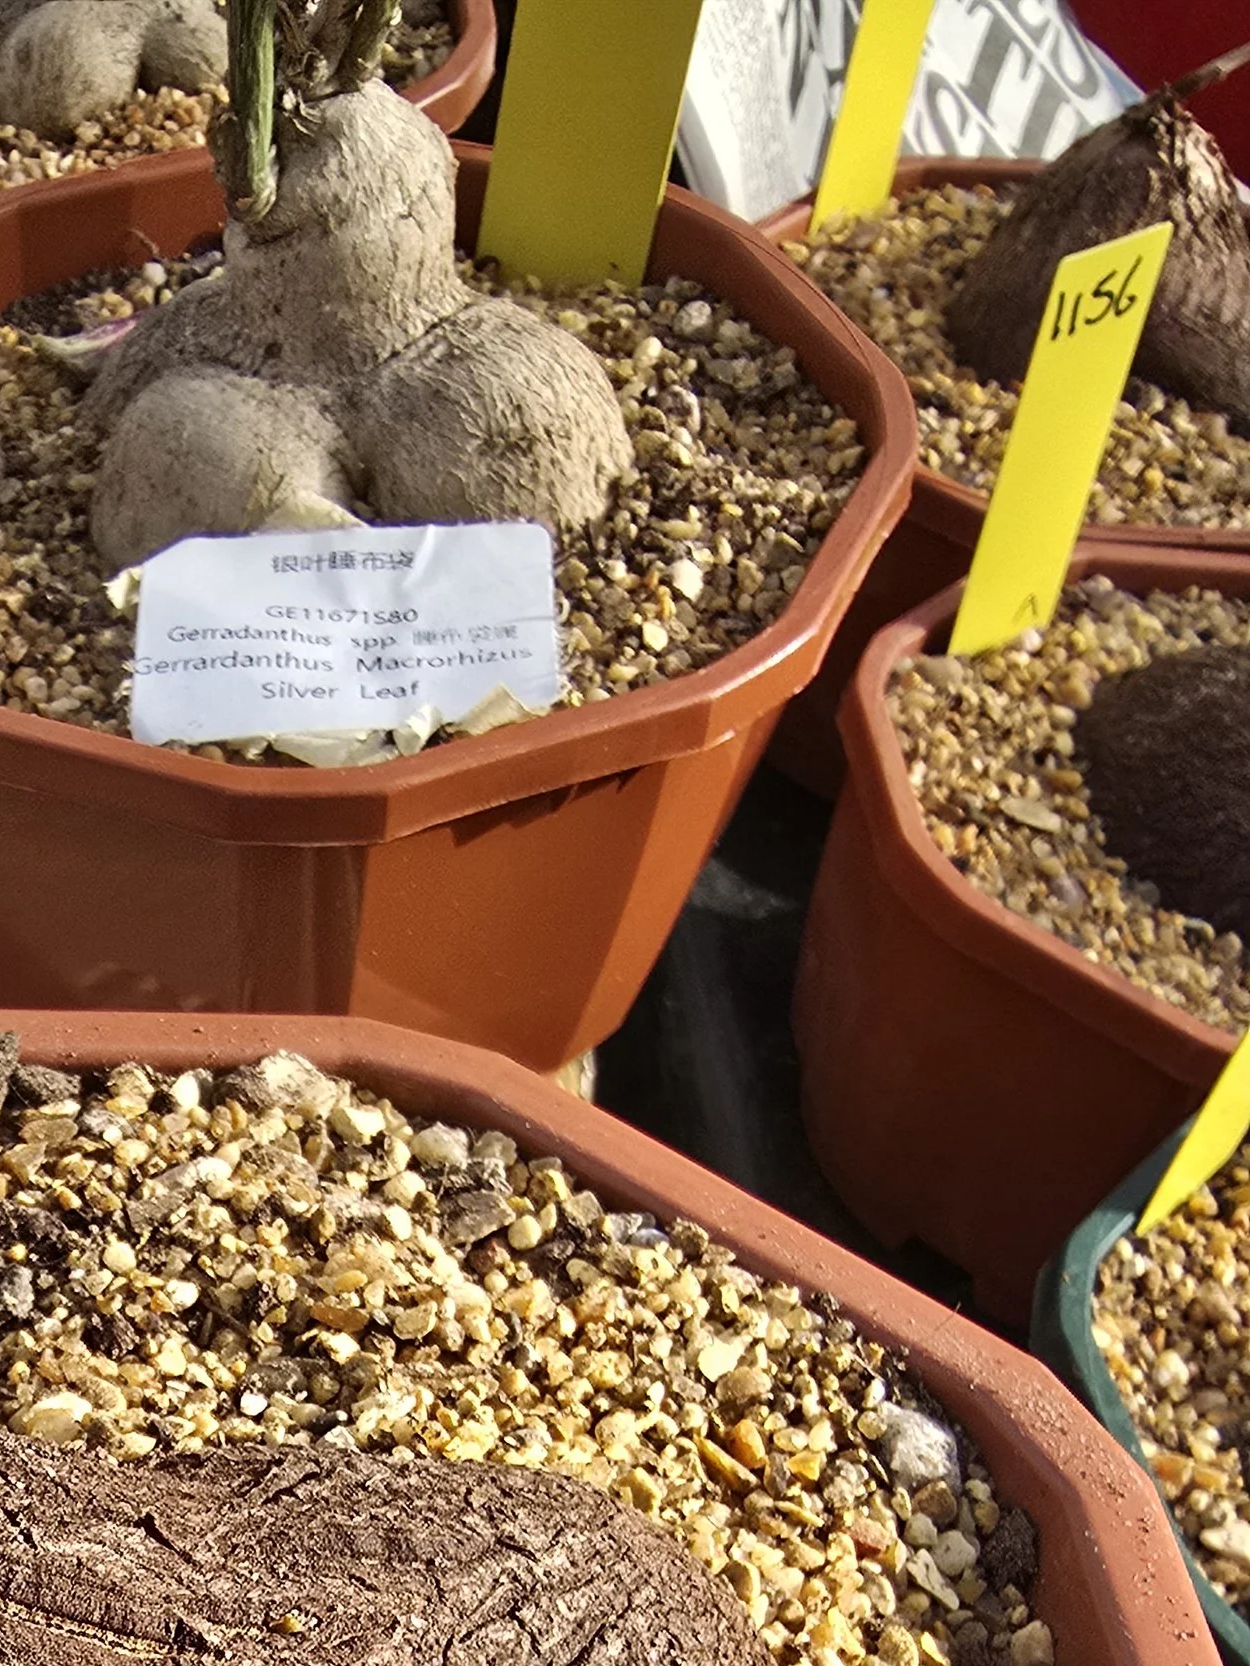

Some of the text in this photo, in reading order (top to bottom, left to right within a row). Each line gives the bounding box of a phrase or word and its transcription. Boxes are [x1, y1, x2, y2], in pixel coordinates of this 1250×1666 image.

[1051, 254, 1143, 341] 1156
[167, 624, 333, 648] Gerradanthus
[134, 648, 534, 676] Gerrardanthus Macrorhizus
[261, 680, 419, 700] Silver Leaf
